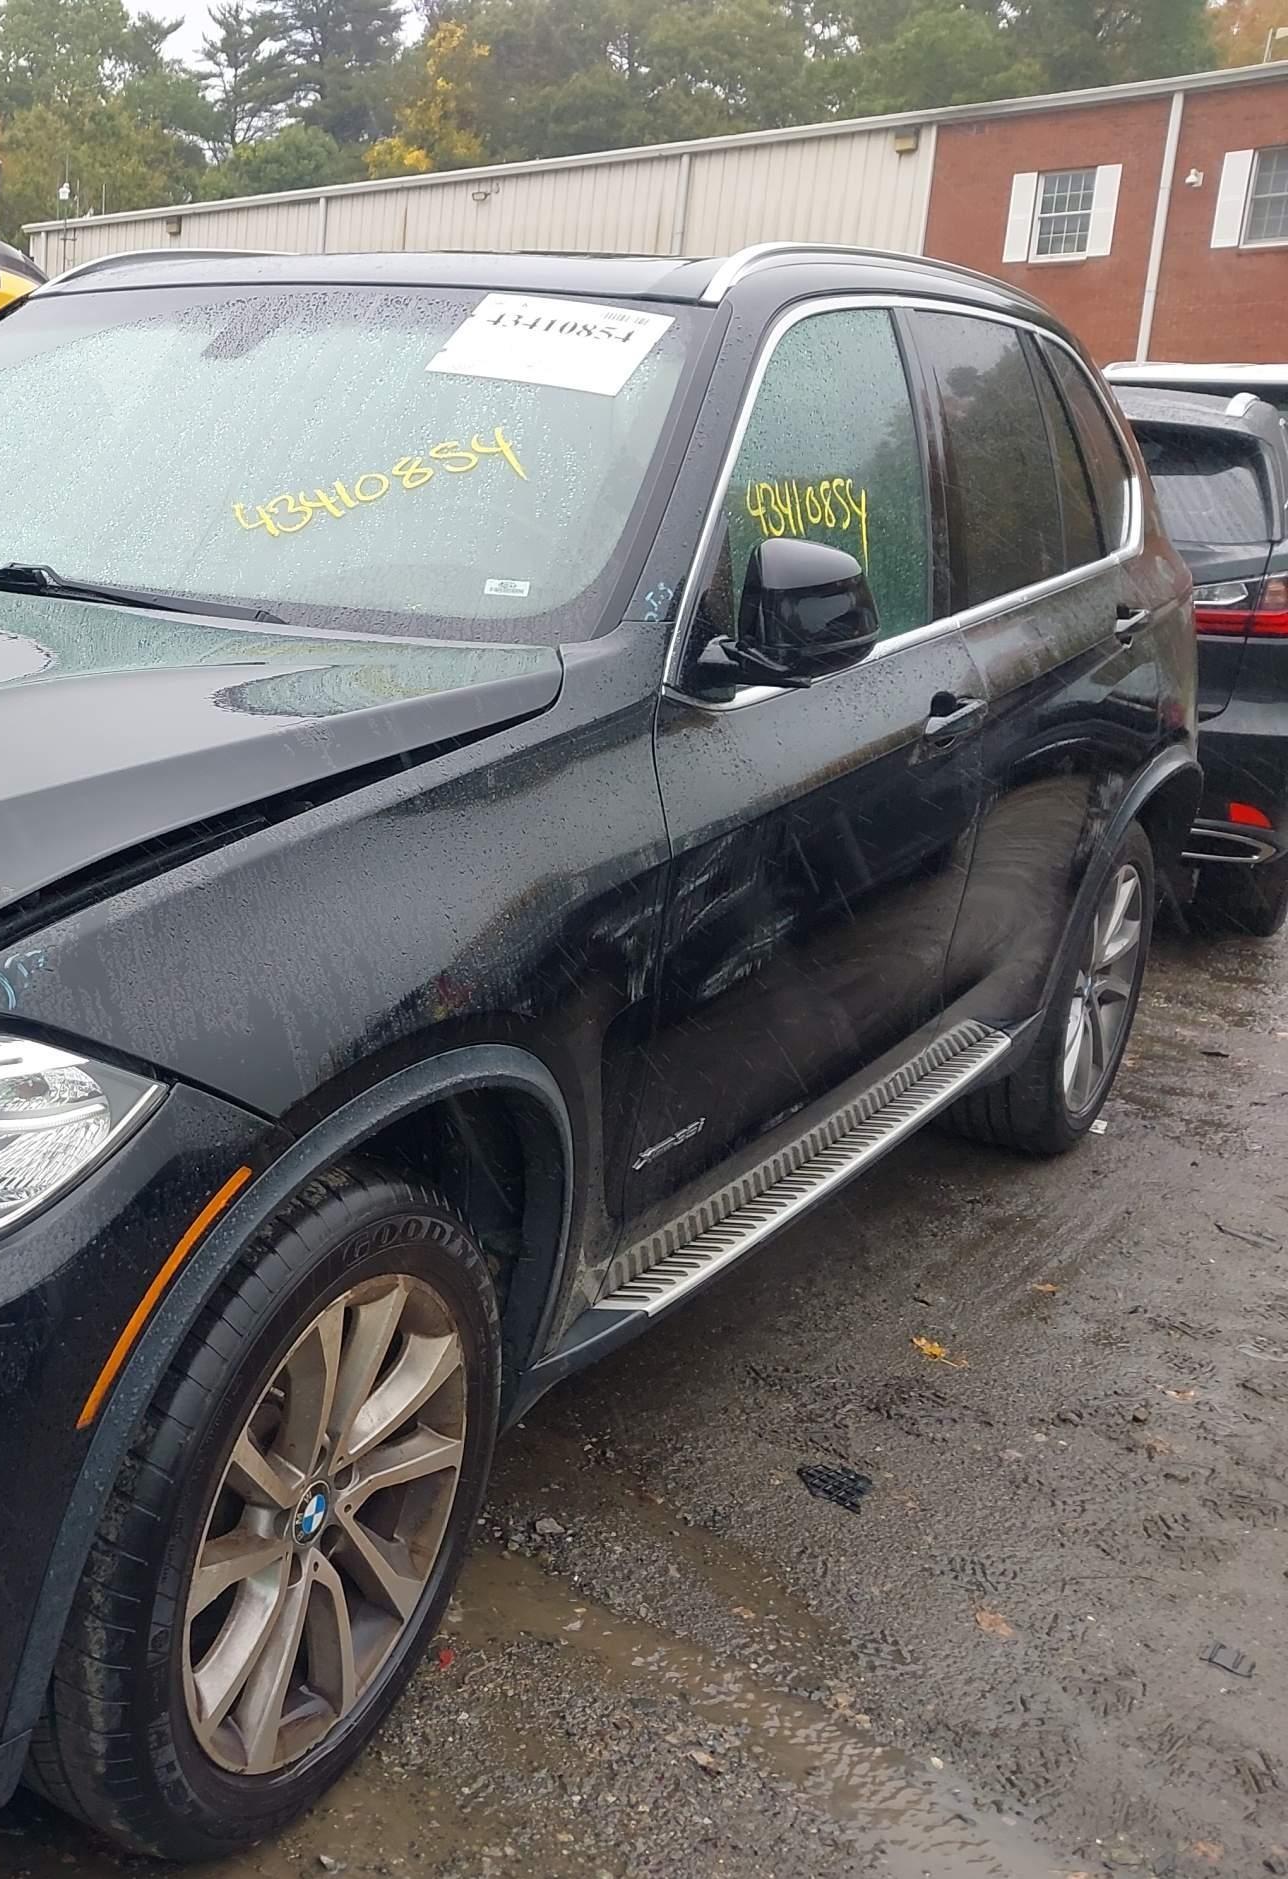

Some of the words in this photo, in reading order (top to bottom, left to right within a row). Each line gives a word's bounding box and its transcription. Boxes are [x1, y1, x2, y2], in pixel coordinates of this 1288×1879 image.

[486, 312, 635, 343] 43410854
[233, 427, 528, 536] 43410854
[747, 478, 869, 577] 43410854
[295, 1491, 313, 1541] BMW
